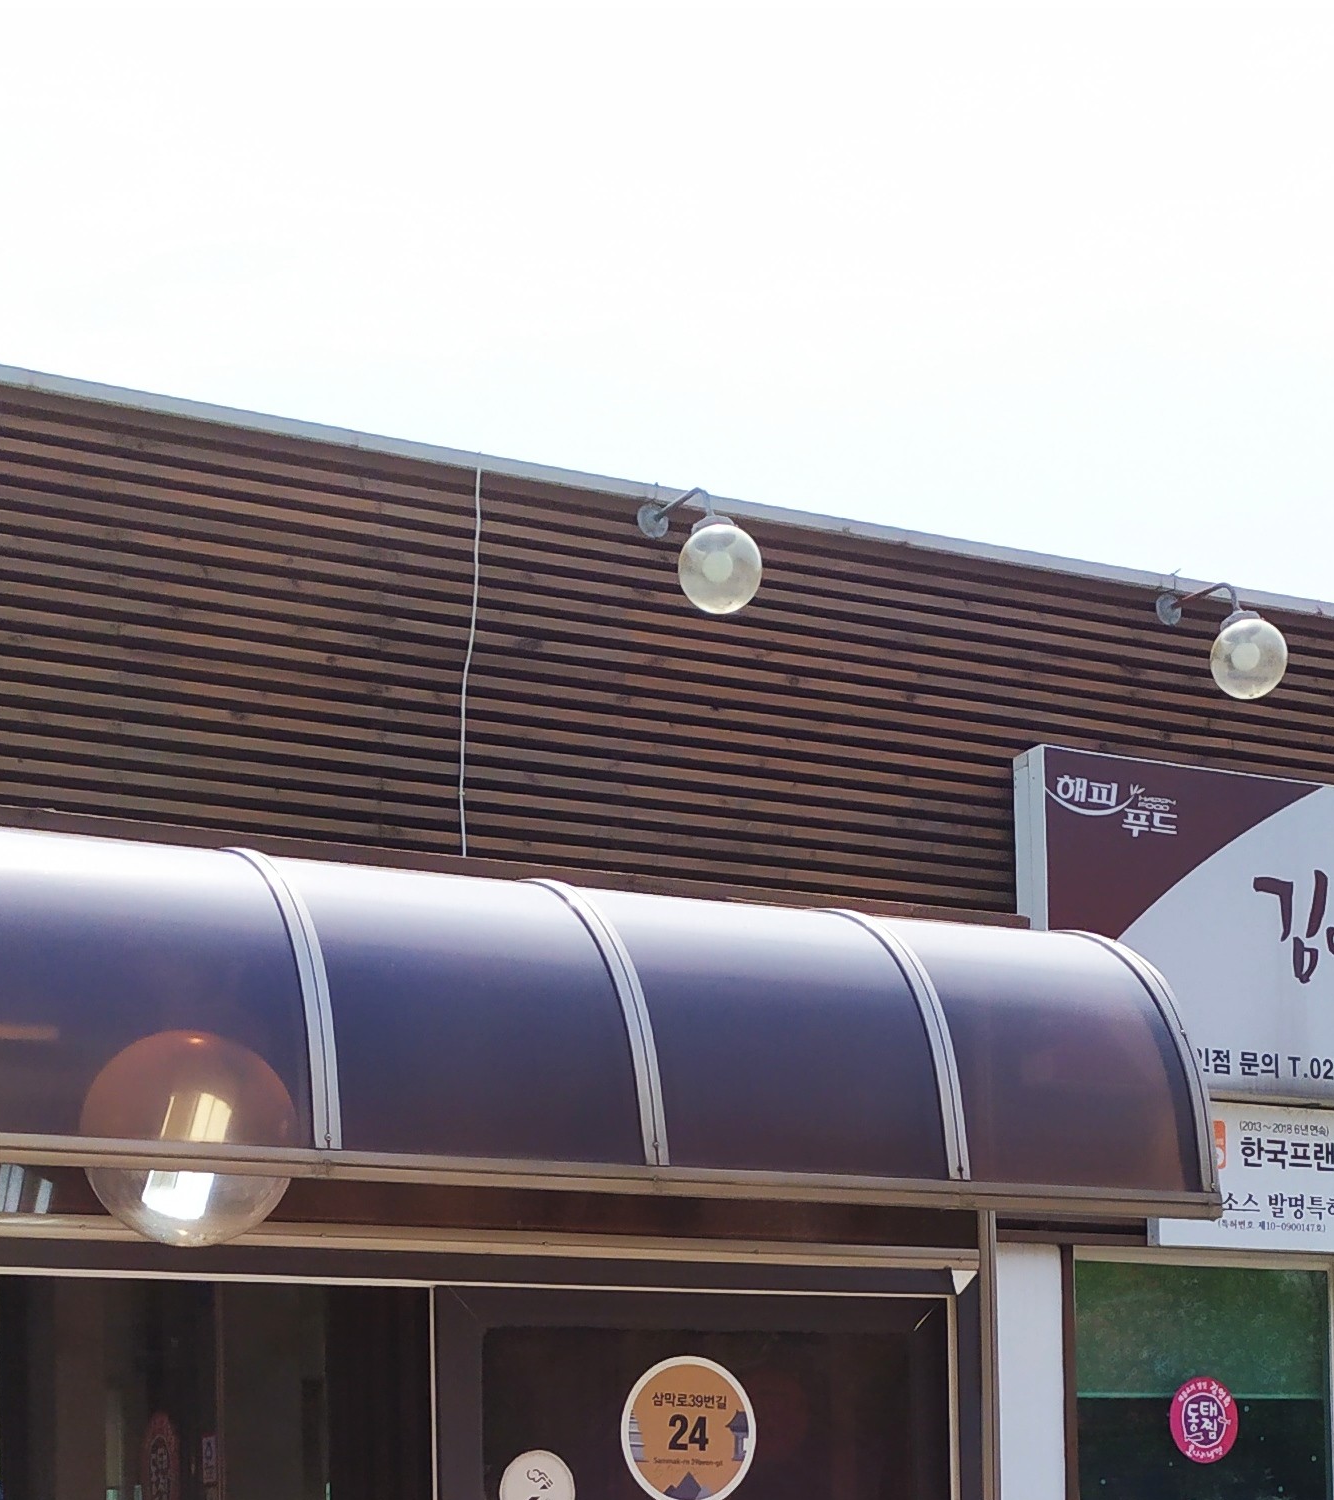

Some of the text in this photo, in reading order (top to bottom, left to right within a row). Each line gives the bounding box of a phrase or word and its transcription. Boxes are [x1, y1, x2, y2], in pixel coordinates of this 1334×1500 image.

[1056, 774, 1118, 807] 해피
[1122, 808, 1178, 838] 푸드
[1239, 1050, 1280, 1079] 문의
[1222, 1191, 1261, 1213] 소스
[652, 1391, 727, 1410] 삼막로39번길
[668, 1413, 709, 1452] 24
